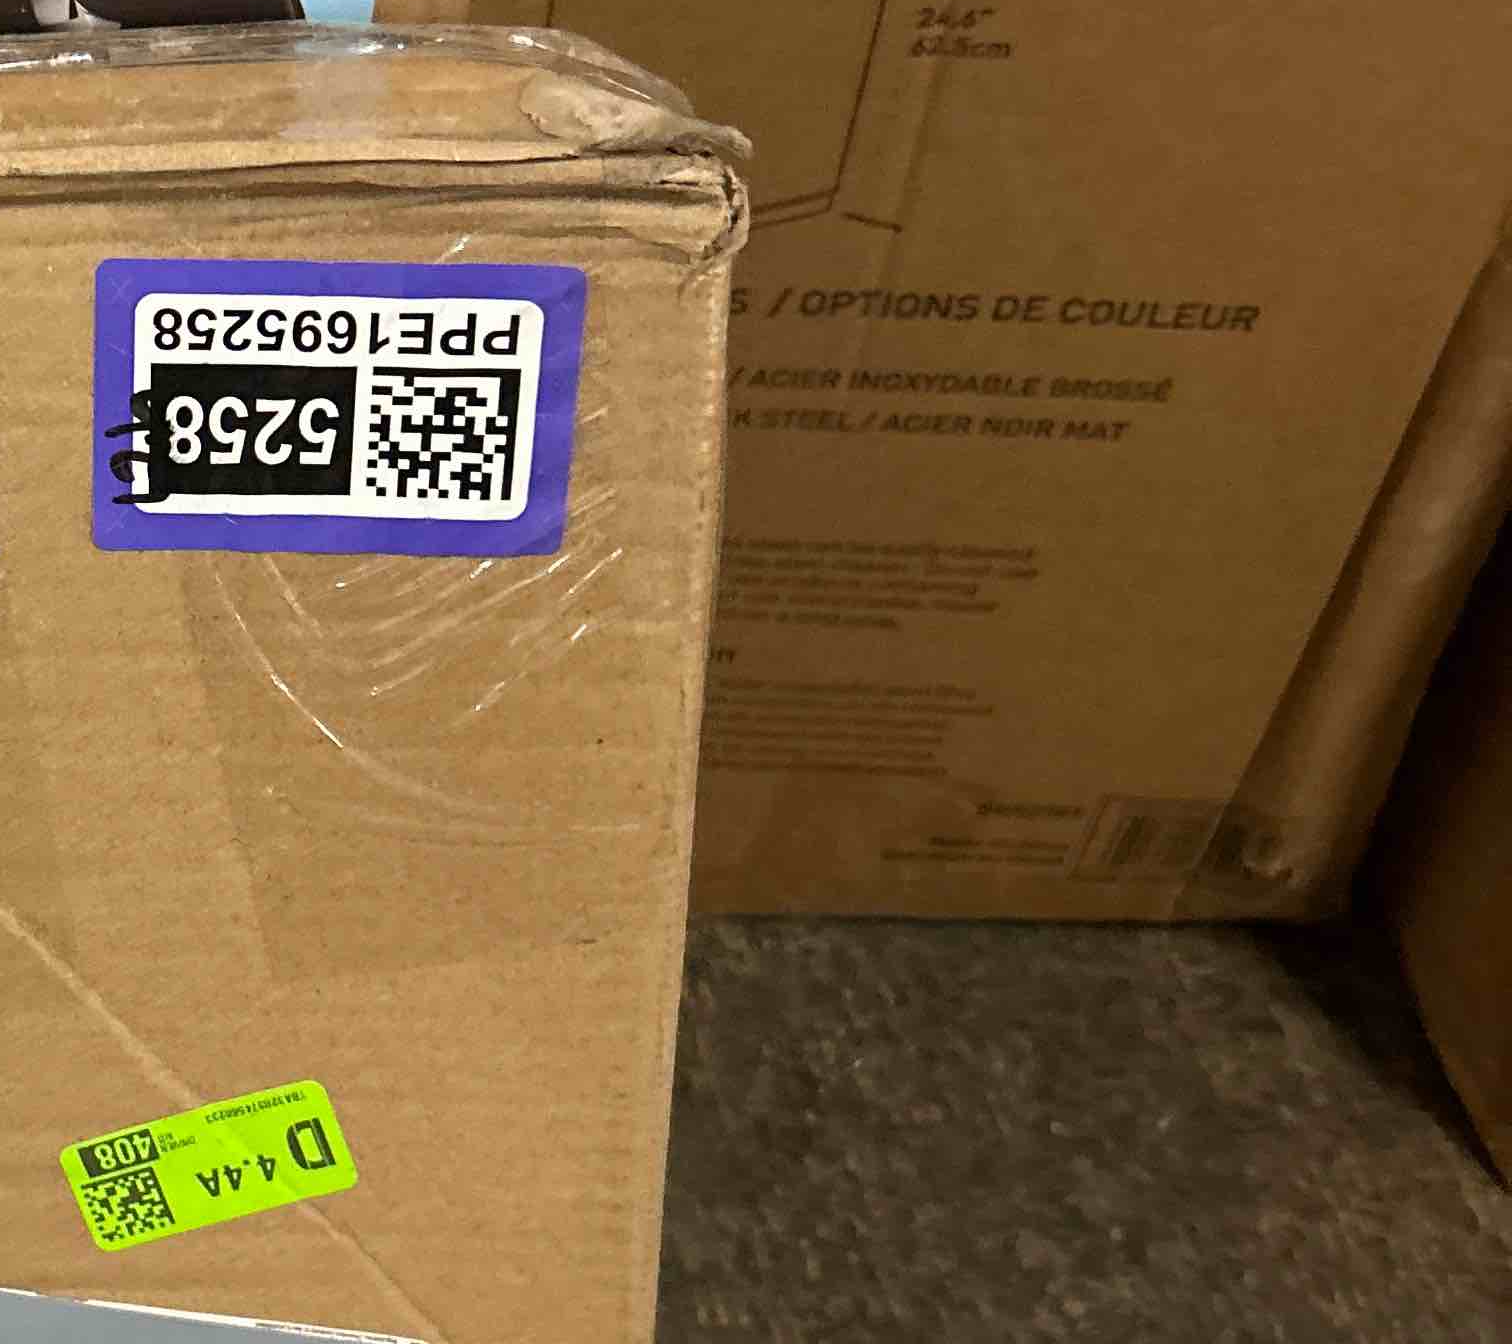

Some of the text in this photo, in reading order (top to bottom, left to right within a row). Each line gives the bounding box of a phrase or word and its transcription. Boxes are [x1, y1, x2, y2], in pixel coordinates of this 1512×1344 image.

[152, 307, 522, 356] PPE1695258
[798, 288, 979, 323] OPTIONS
[990, 293, 1051, 324] DE
[1057, 296, 1264, 333] COULEUR
[749, 367, 844, 393] ACIER
[847, 369, 1041, 400] INOXYDABLE
[165, 395, 341, 466] 5258
[880, 411, 972, 436] ACIER
[1062, 419, 1131, 443] MAT
[94, 1133, 151, 1170] 408
[194, 1116, 337, 1197] 4.4A D
